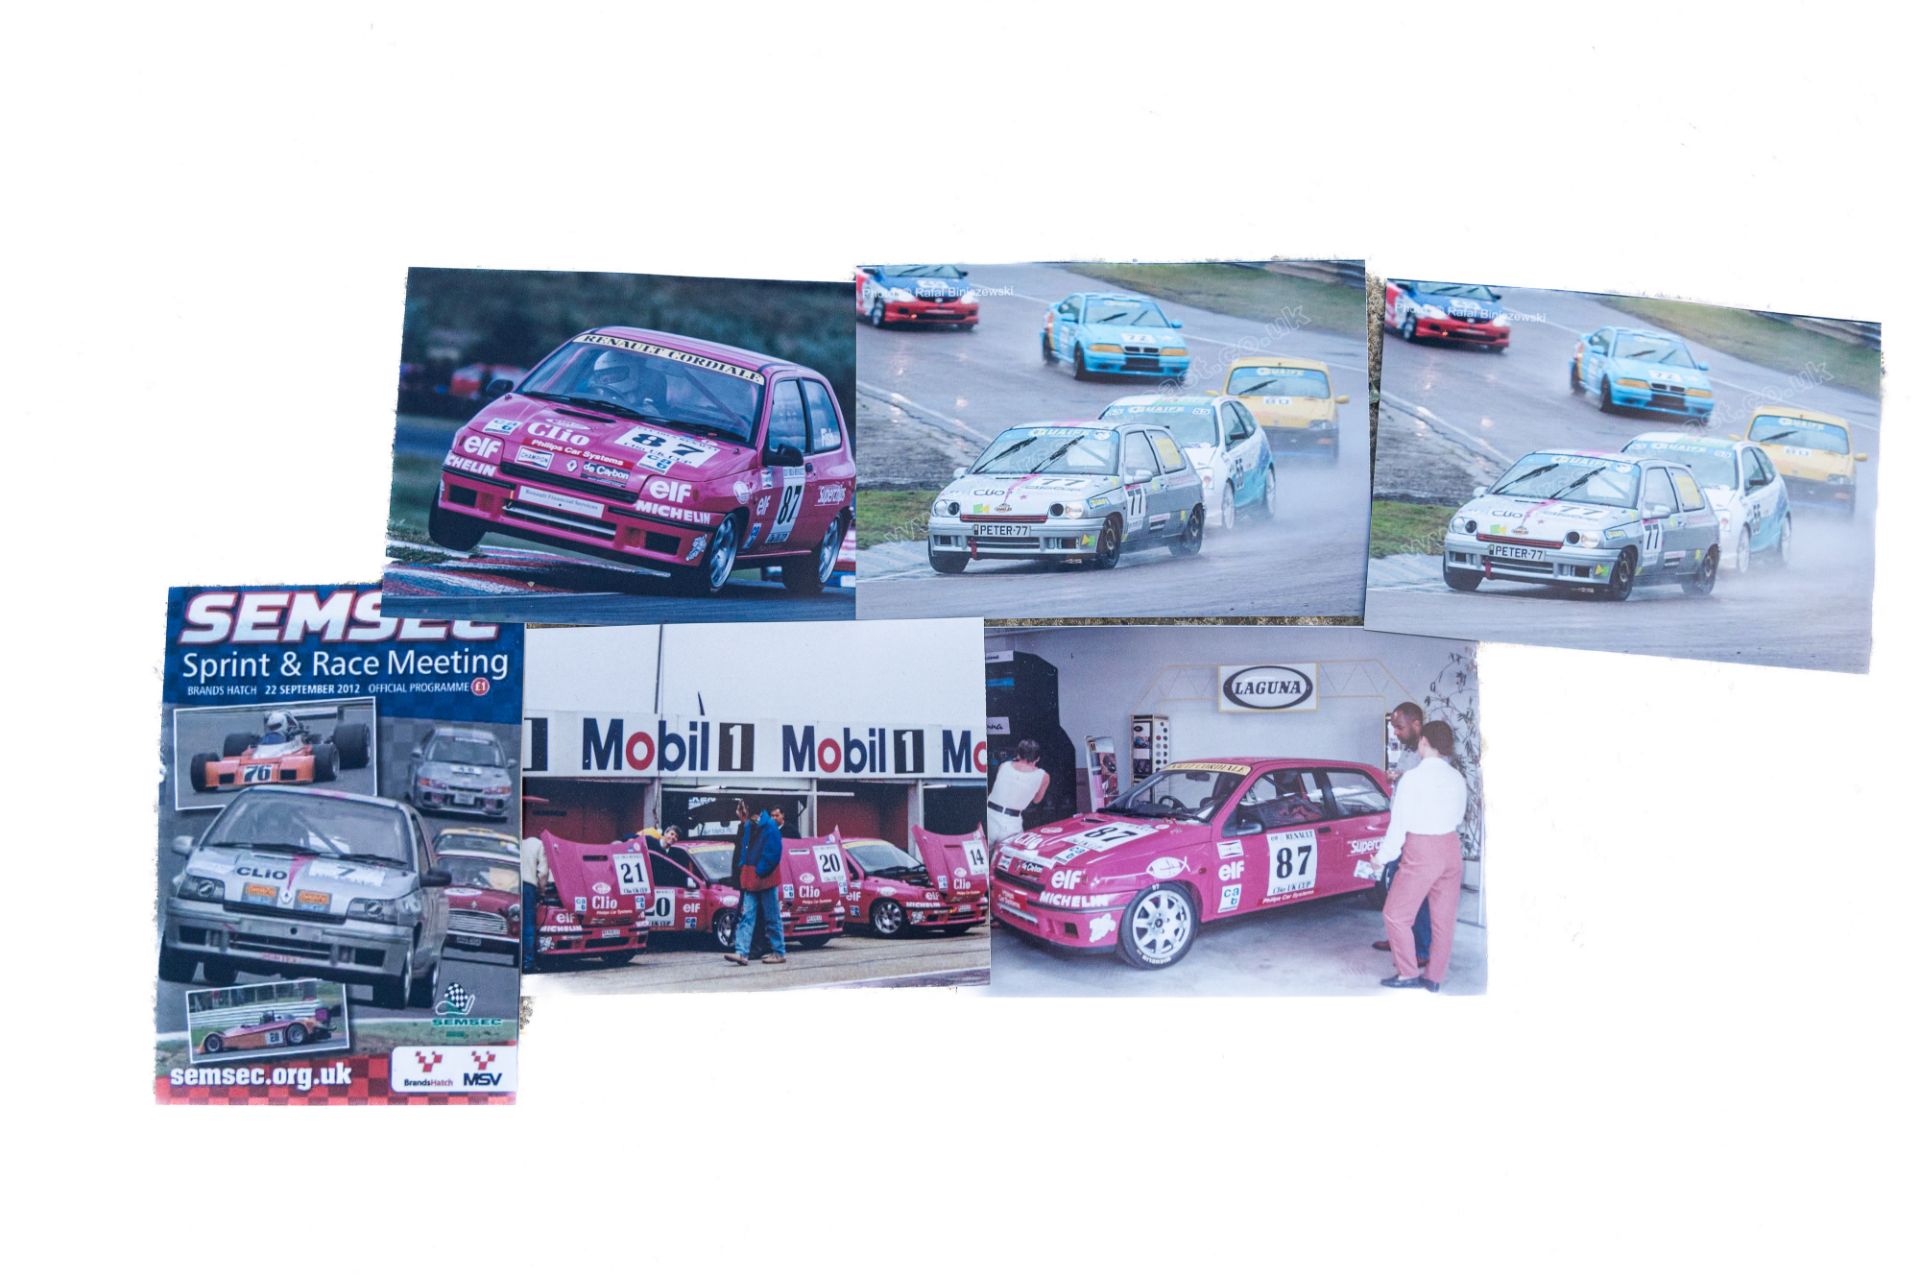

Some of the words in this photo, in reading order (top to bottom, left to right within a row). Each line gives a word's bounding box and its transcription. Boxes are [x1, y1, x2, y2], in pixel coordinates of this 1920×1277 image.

[584, 335, 665, 355] RENAULT
[668, 350, 762, 383] CORDIALE
[527, 421, 590, 446] Clio
[463, 435, 502, 459] elf
[632, 433, 705, 457] 87
[564, 445, 581, 456] Car
[582, 450, 624, 467] Systems
[649, 480, 692, 504] elf
[1126, 489, 1143, 516] 77
[635, 500, 711, 525] MICHELIN
[756, 496, 771, 516] elf
[777, 485, 803, 526] 87
[1644, 523, 1660, 551] 77
[183, 650, 270, 684] Sprint
[280, 651, 301, 677] &
[313, 651, 380, 677] Race
[388, 647, 509, 681] Meeting
[187, 685, 225, 696] BRANDS
[227, 684, 257, 696] HATCH
[264, 684, 277, 695] 22
[279, 683, 335, 695] SEPTEMBER
[336, 683, 361, 694] 2012
[368, 682, 407, 693] OFFICIAL
[409, 681, 470, 693] PROGRAMME
[475, 681, 487, 692] £1
[1234, 680, 1302, 695] LAGUNA
[582, 717, 710, 771] Mobil
[781, 724, 887, 774] Mobil
[1084, 826, 1138, 843] 87
[1286, 831, 1313, 841] RENAULT
[819, 853, 841, 873] 20
[970, 849, 984, 866] 14
[1275, 844, 1313, 879] 87
[620, 862, 644, 884] 21
[1051, 869, 1082, 890] elf
[1218, 860, 1245, 881] elf
[799, 885, 820, 899] Clio
[953, 879, 972, 890] Clio
[592, 895, 618, 910] Clio
[683, 903, 700, 914] elf
[1039, 891, 1112, 909] MICHELIN
[556, 913, 575, 923] elf
[432, 1017, 503, 1027] SEMSEC
[170, 1062, 352, 1091] semsec.org.uk
[463, 1072, 503, 1086] MSV
